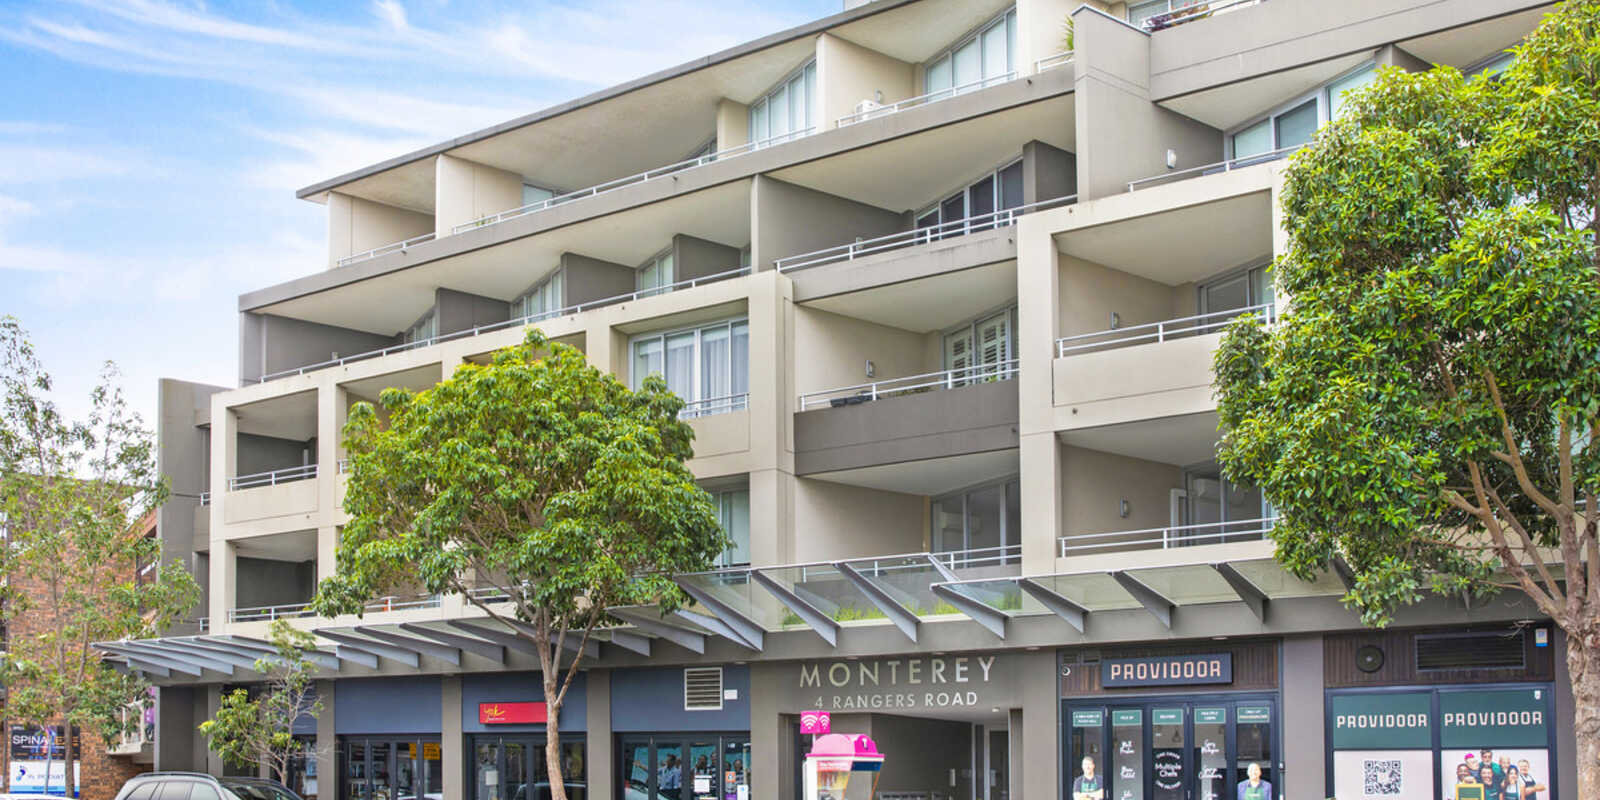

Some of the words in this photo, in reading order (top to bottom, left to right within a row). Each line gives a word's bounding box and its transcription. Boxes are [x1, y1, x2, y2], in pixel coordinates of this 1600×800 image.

[799, 656, 995, 687] MONTEREY
[1111, 660, 1221, 680] PROVIDOOR
[815, 697, 823, 710] 4
[832, 694, 915, 709] RANGERS
[924, 692, 978, 707] ROAD
[1336, 713, 1428, 729] PROVIDOOR
[1444, 711, 1543, 727] PROVIDOOR
[12, 735, 53, 745] SPINA
